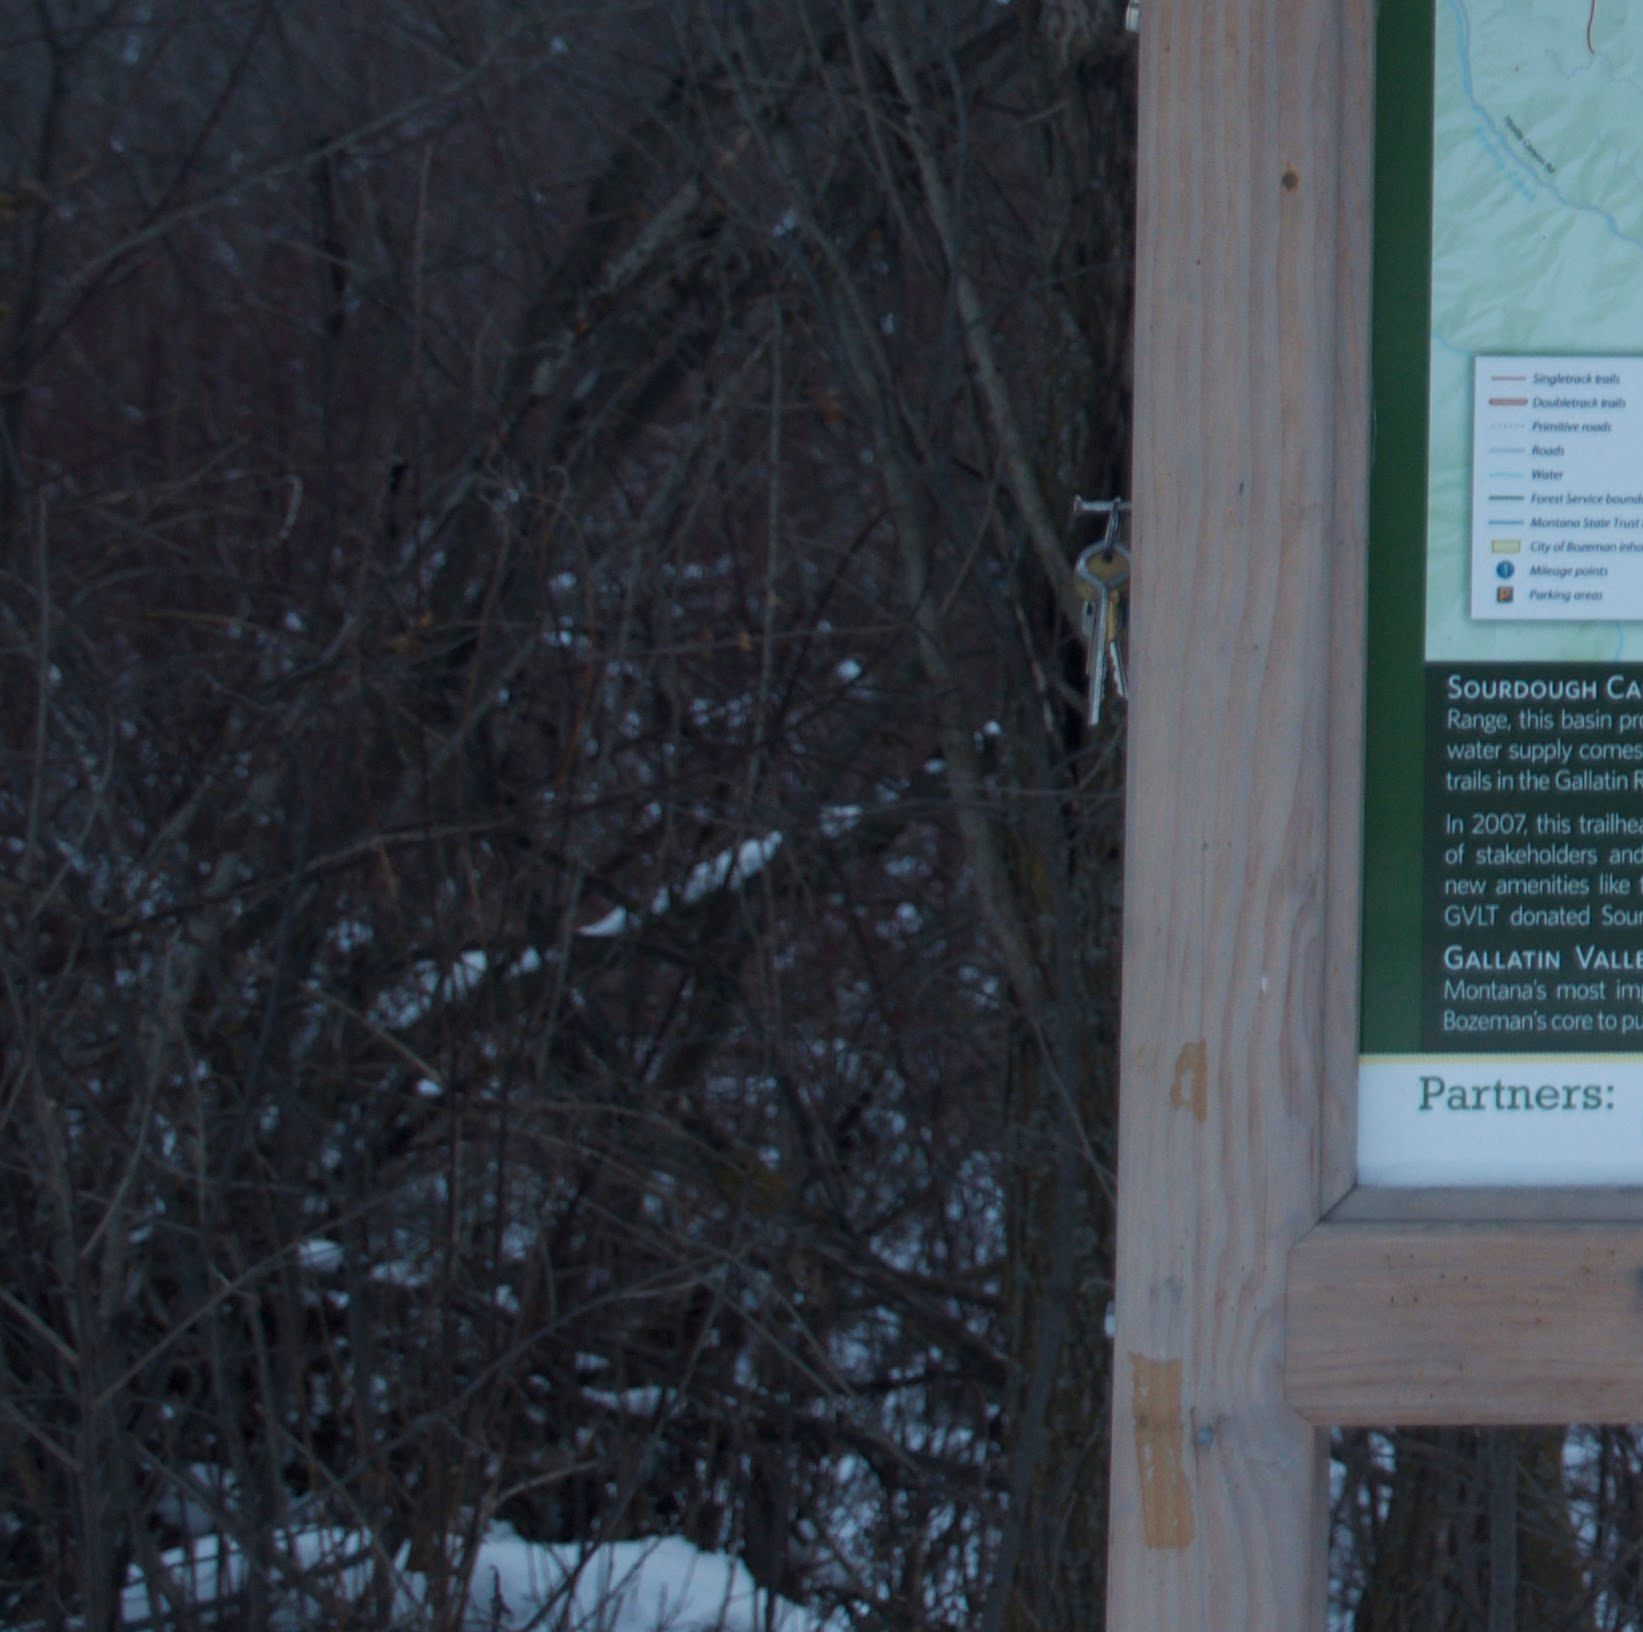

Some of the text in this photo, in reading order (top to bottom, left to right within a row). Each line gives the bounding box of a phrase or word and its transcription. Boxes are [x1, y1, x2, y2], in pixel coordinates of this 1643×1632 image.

[1444, 1010, 1547, 1031] Bozeman's
[1551, 1015, 1593, 1031] core
[1597, 1012, 1617, 1030] to
[1419, 1076, 1614, 1111] Partners:
